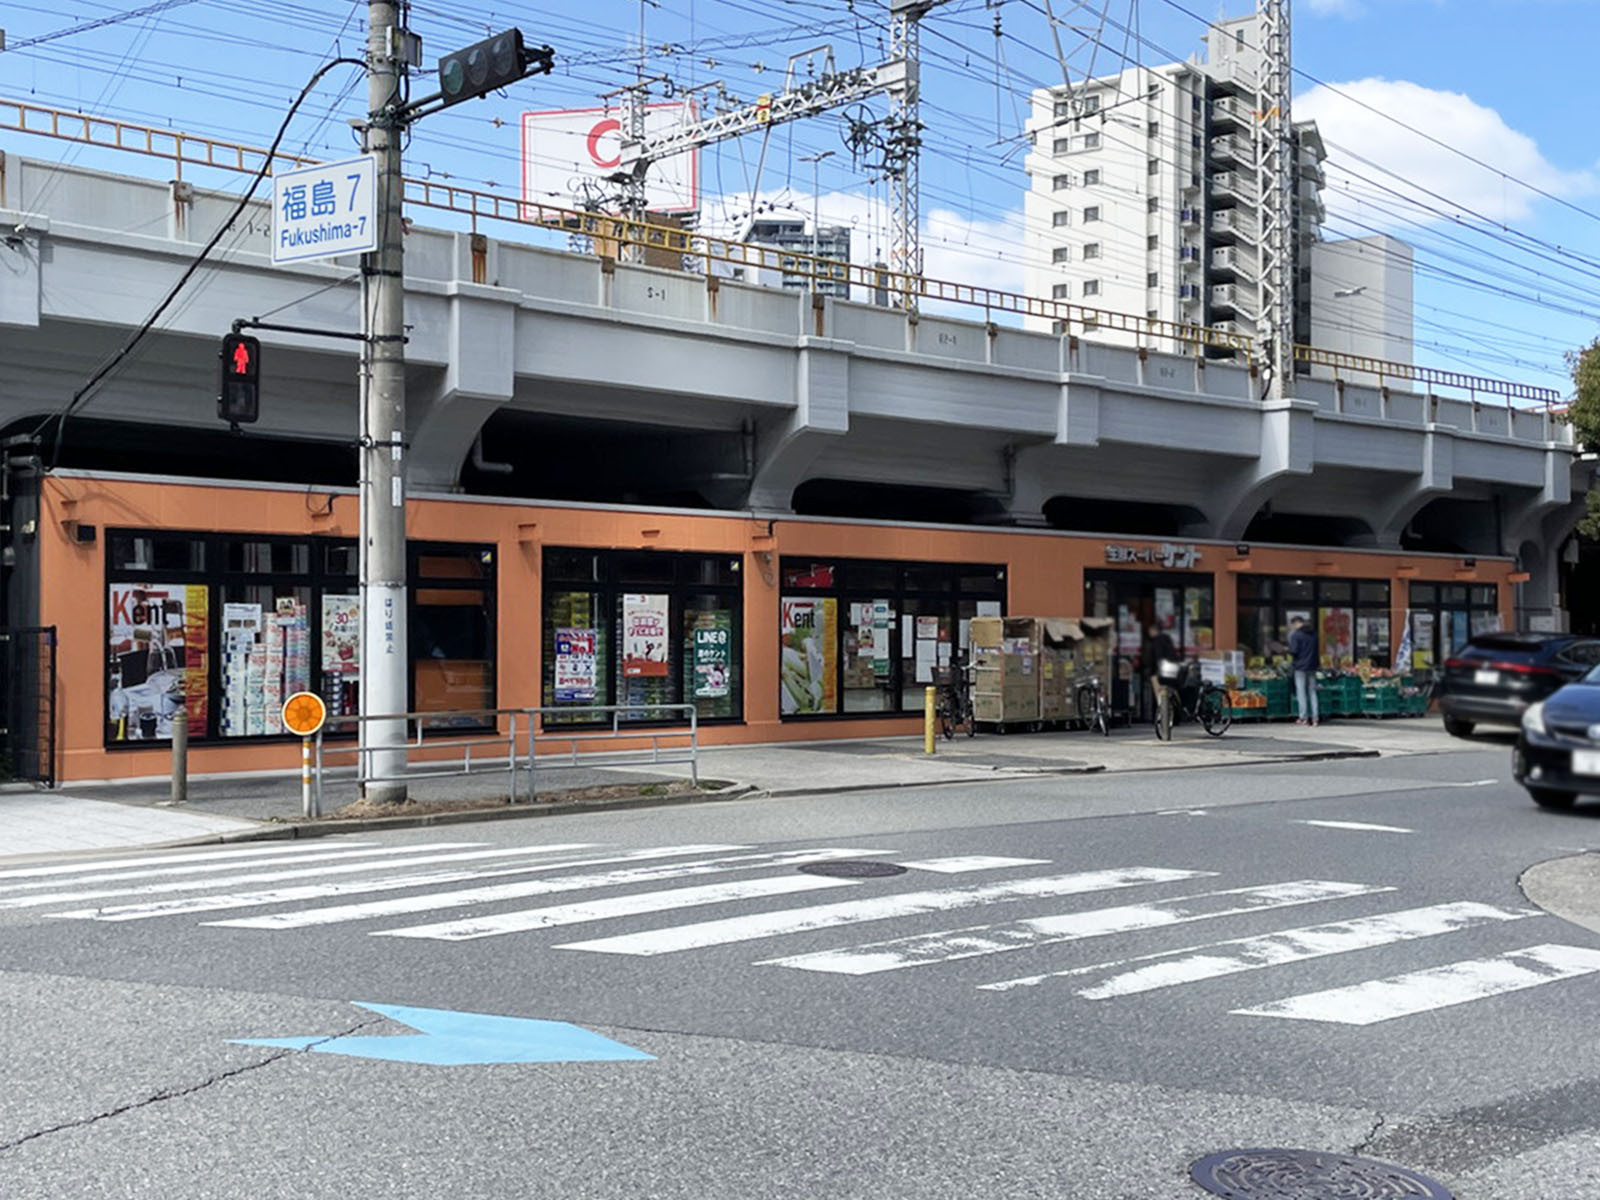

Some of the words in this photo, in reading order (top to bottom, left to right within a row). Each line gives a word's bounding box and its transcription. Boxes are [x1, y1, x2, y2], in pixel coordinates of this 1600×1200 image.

[281, 180, 336, 223] 福島
[347, 173, 361, 212] 7
[280, 215, 366, 248] Fukushima-7
[112, 590, 169, 626] Kent
[783, 602, 815, 629] Kent
